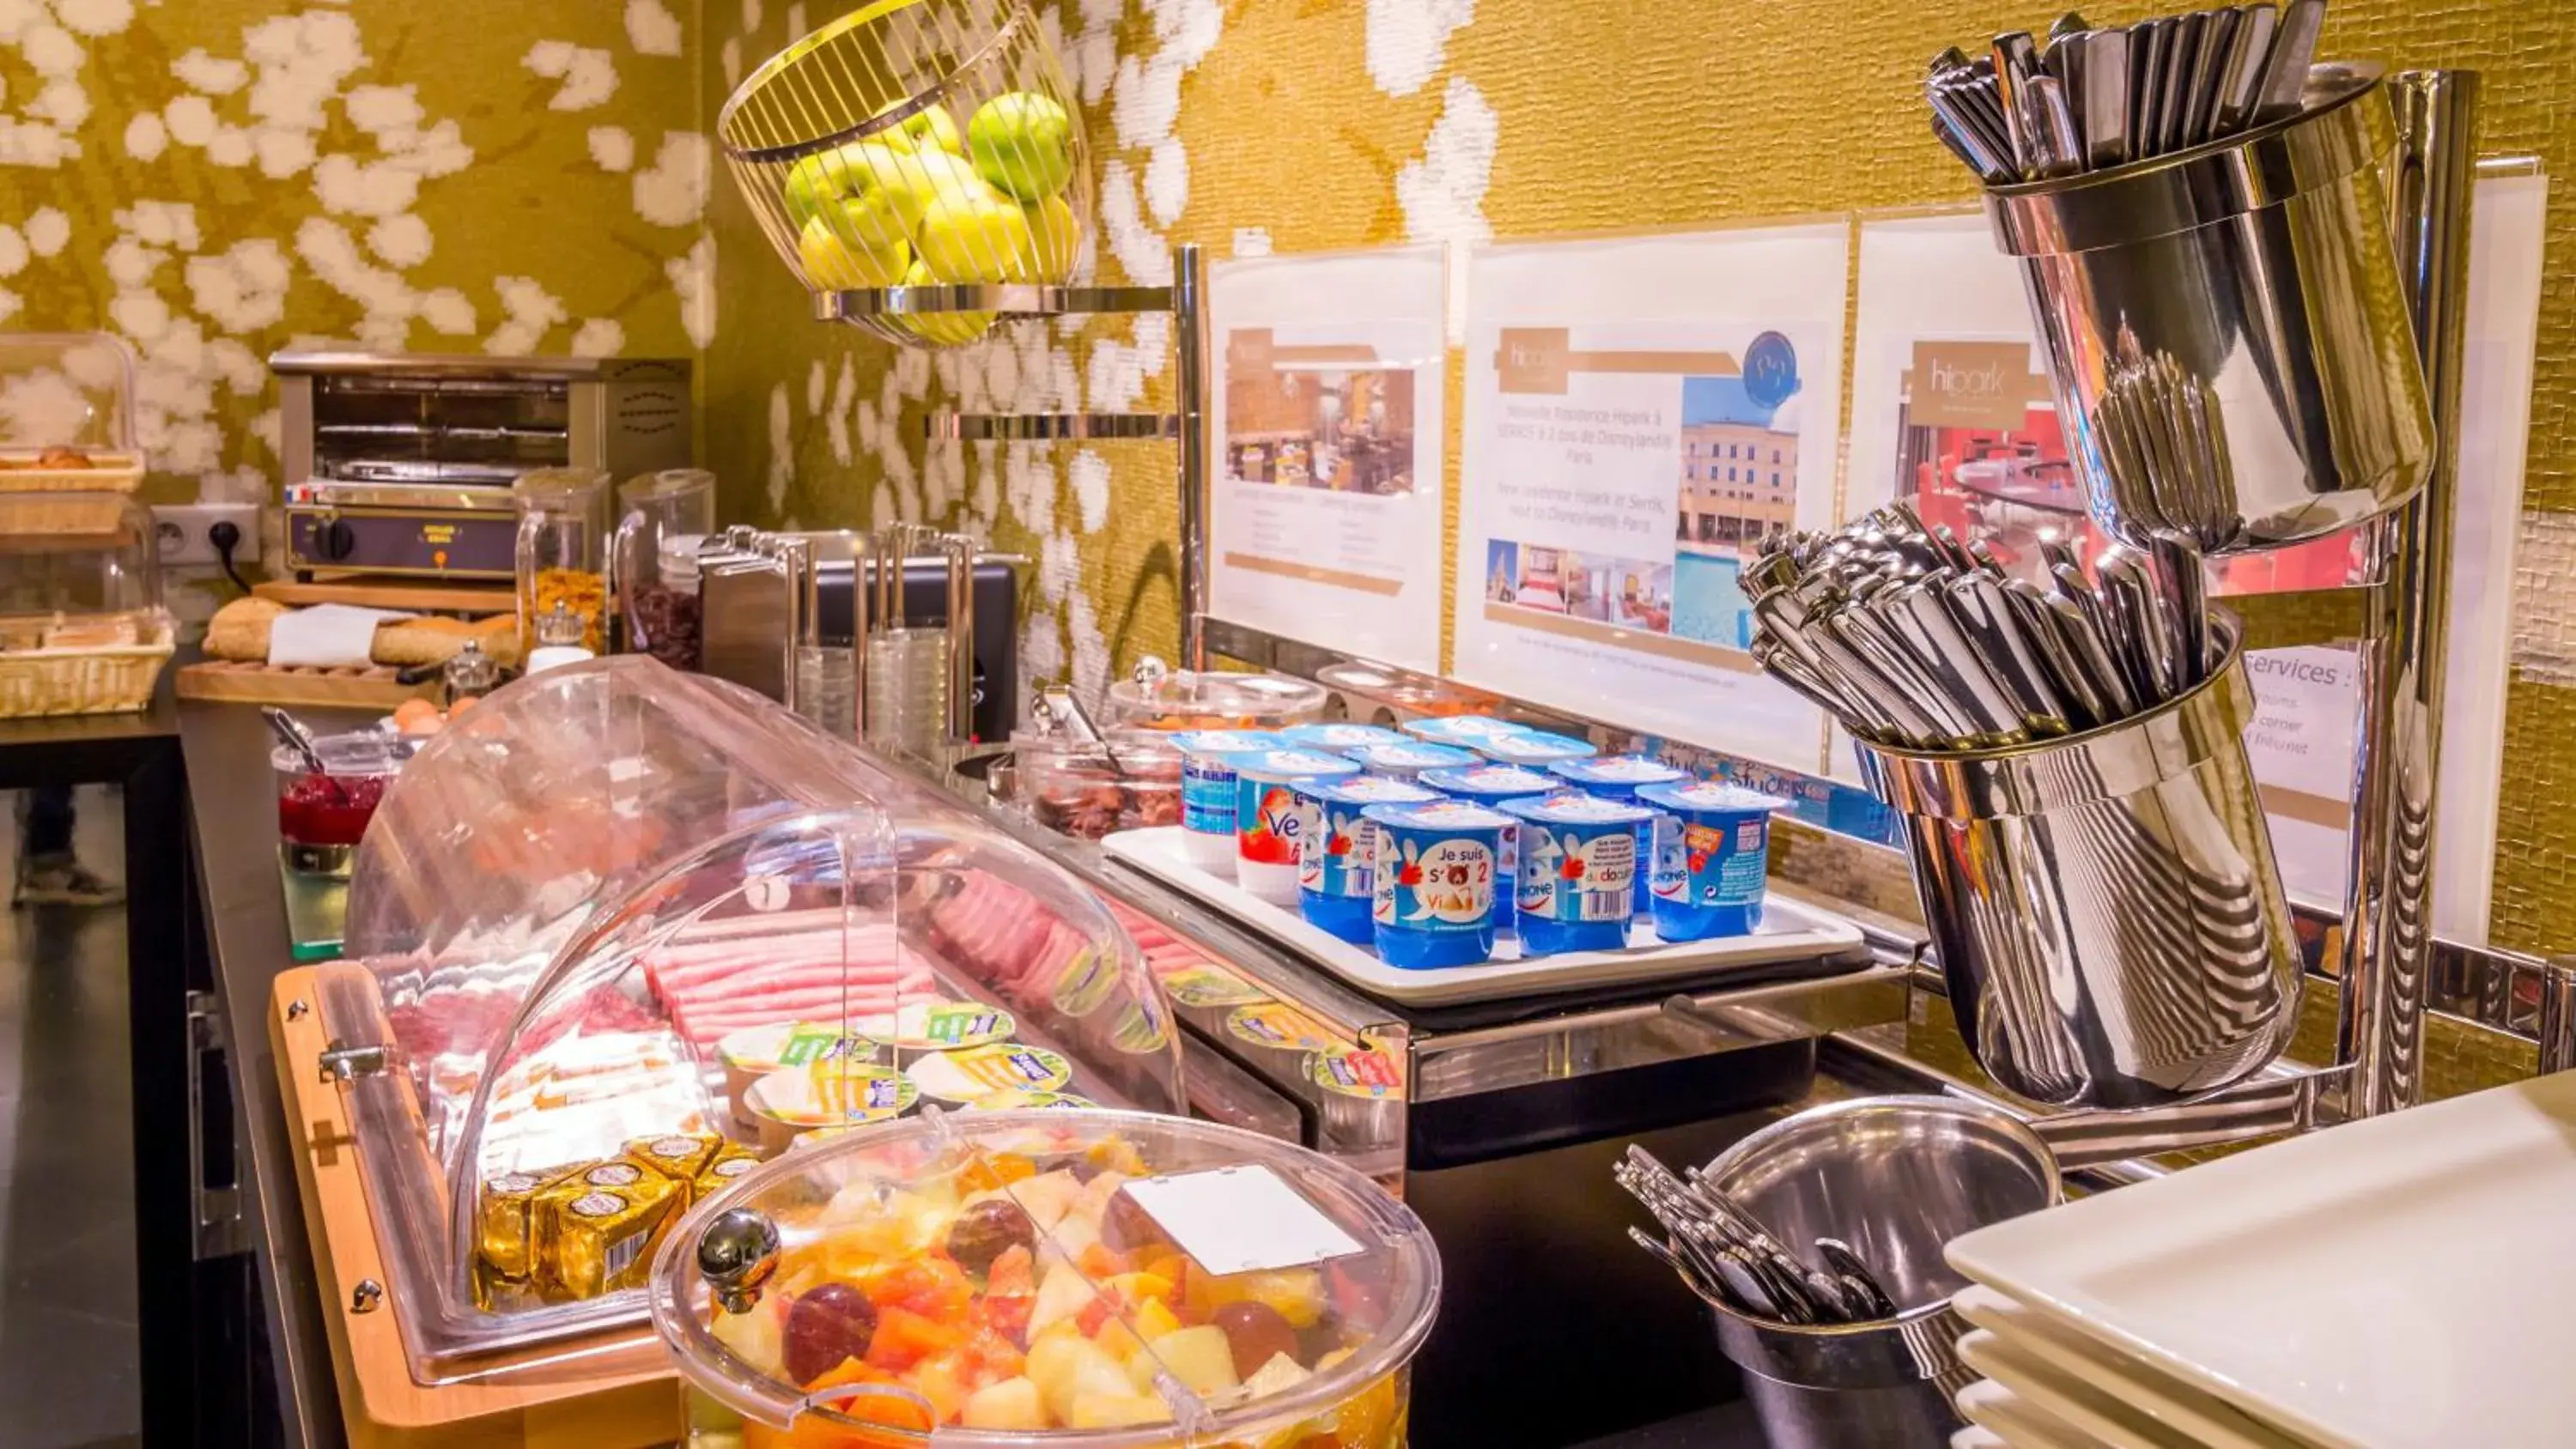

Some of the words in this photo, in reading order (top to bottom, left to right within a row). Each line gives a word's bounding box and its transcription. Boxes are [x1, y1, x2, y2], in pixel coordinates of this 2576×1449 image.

[1931, 356, 2004, 397] hipark
[1438, 847, 1455, 861] Je
[1460, 846, 1484, 861] suis
